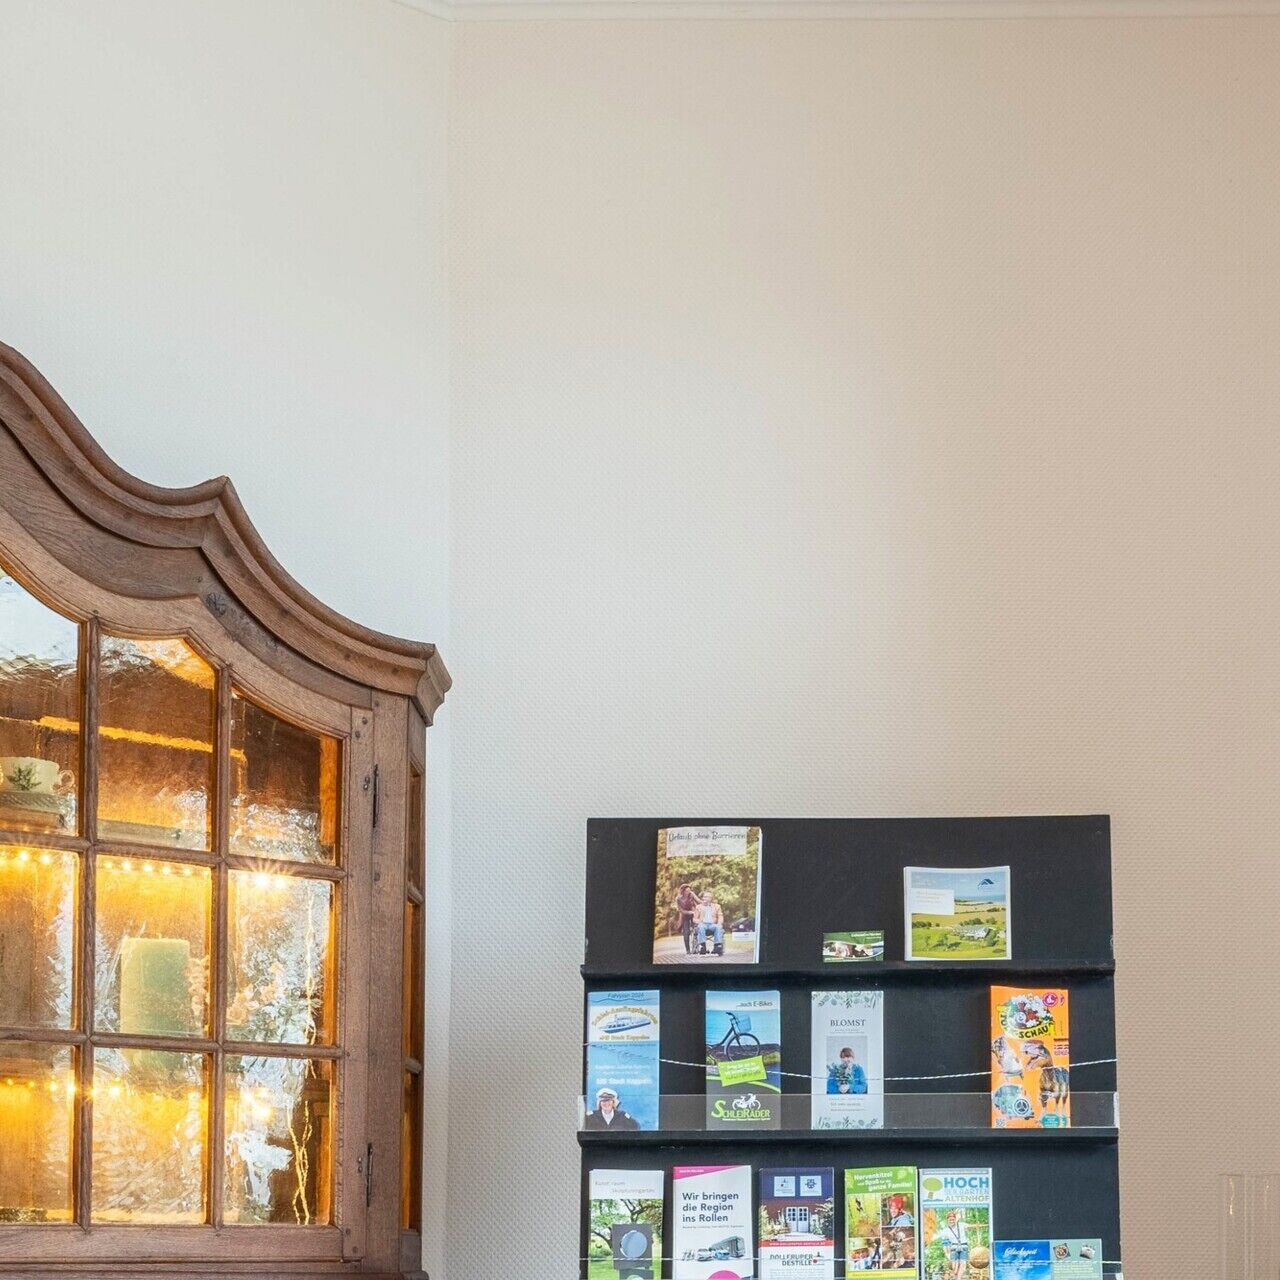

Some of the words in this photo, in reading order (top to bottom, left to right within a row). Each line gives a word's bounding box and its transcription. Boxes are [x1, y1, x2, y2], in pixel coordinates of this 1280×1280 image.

[830, 1019, 866, 1027] BLOMST
[943, 1176, 989, 1188] HOCH
[682, 1192, 700, 1201] Wir
[702, 1192, 739, 1203] bringen
[682, 1203, 698, 1212] die
[700, 1202, 734, 1213] Region
[682, 1214, 696, 1222] ins
[699, 1213, 729, 1222] Rollen
